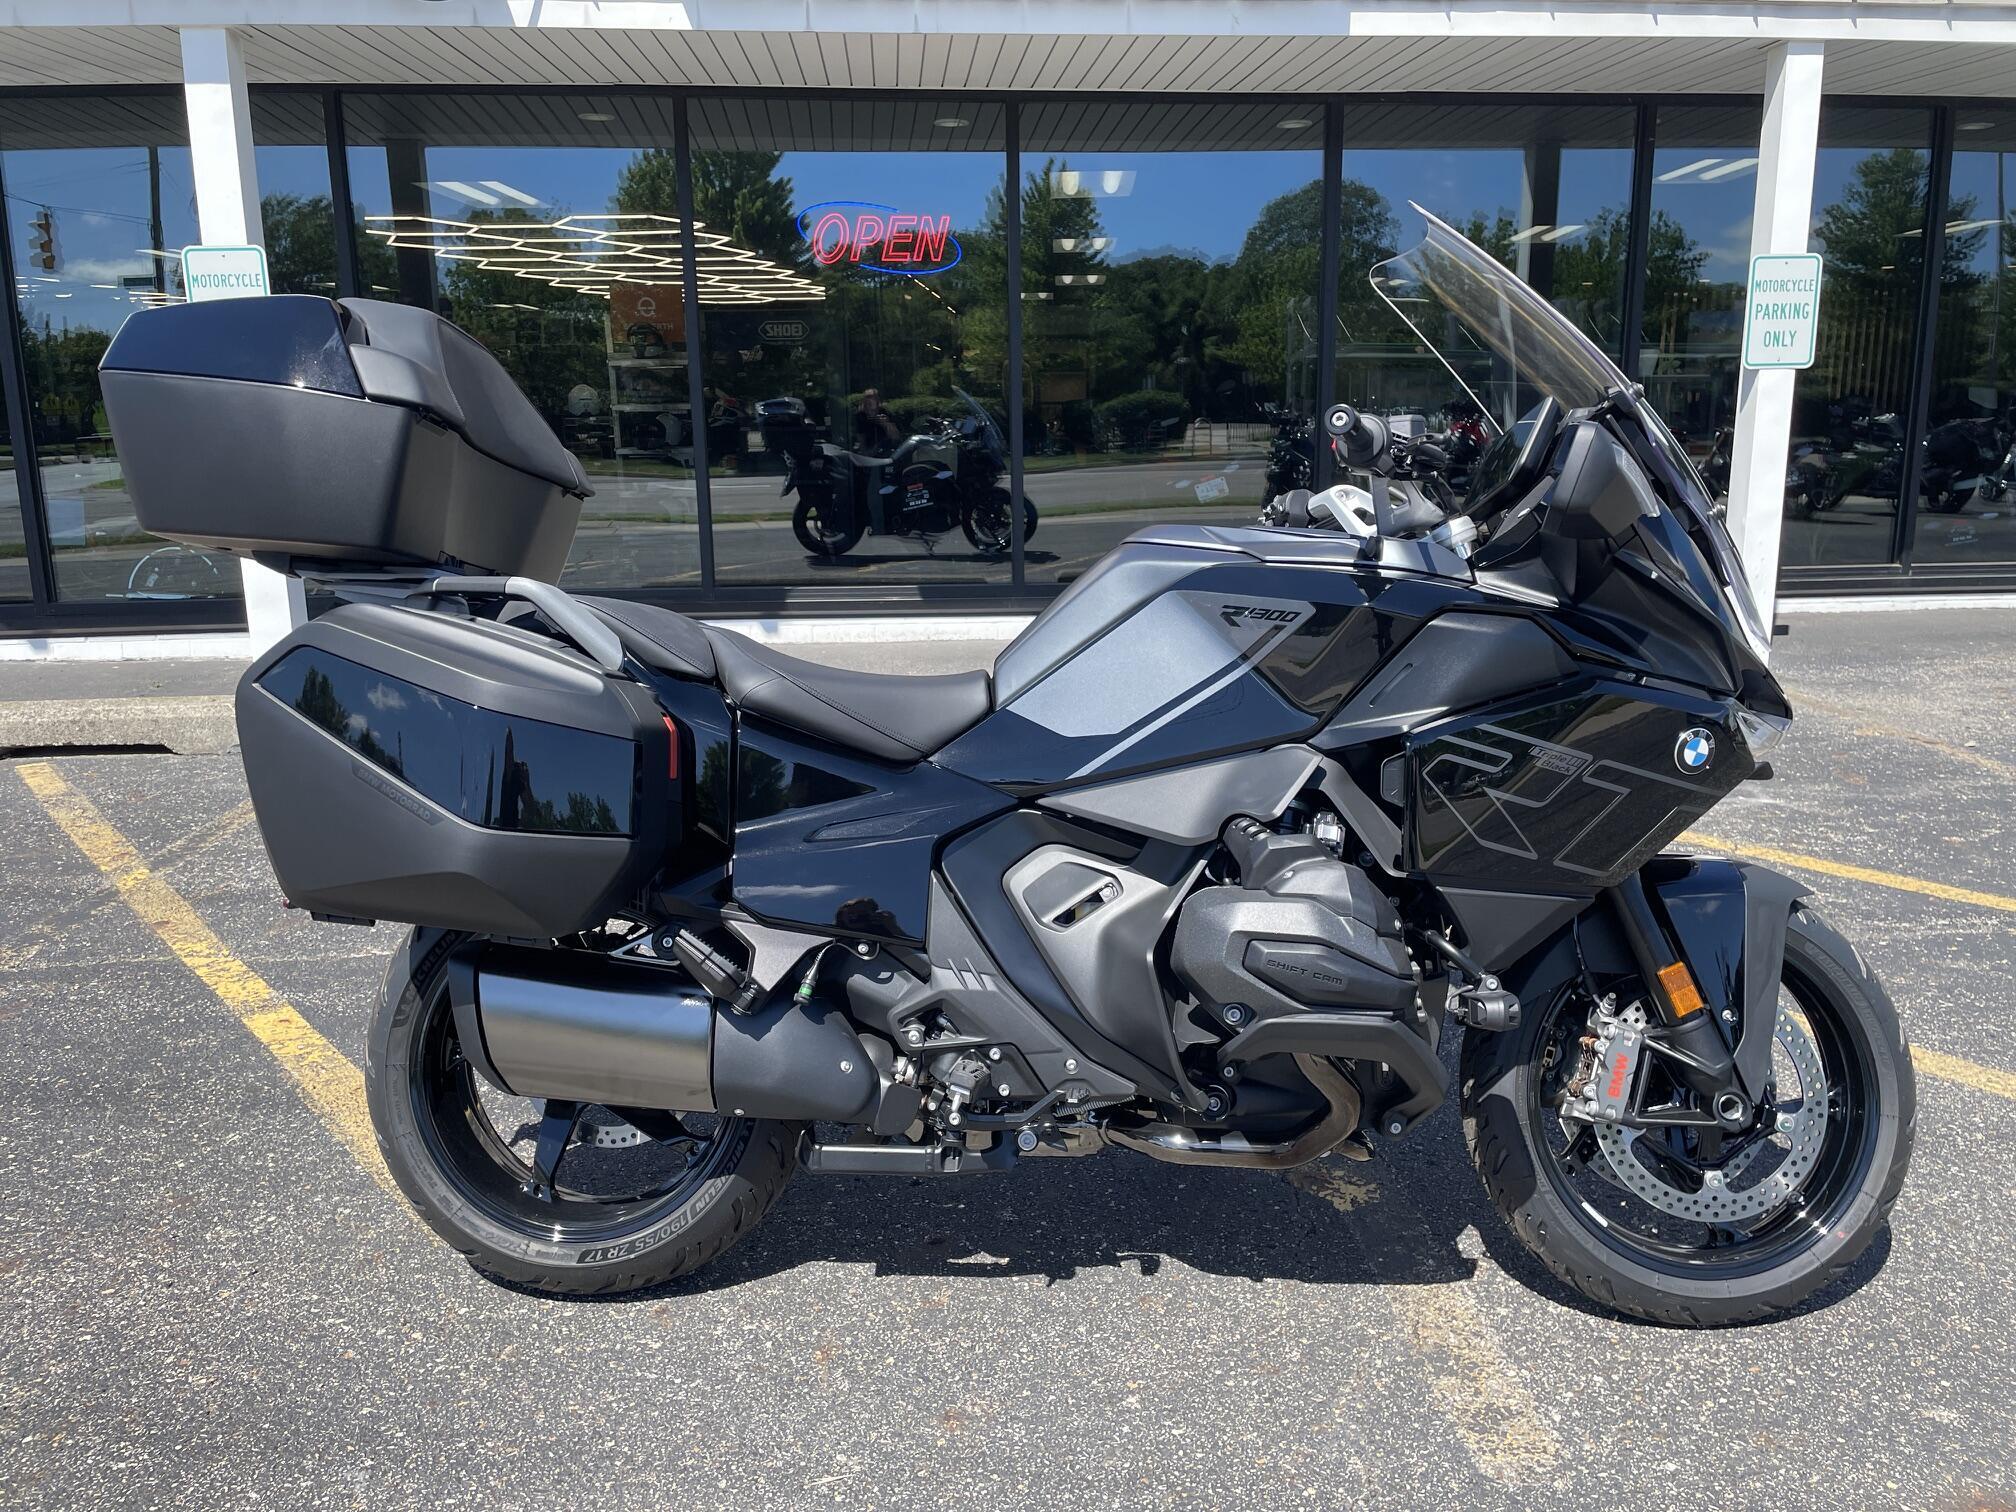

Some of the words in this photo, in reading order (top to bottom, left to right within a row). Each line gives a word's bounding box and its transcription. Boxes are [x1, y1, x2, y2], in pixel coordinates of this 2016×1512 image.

[813, 212, 950, 264] OPEN
[192, 273, 262, 288] MOTORCYCLE
[1754, 279, 1815, 293] MOTORCYCLE
[1755, 303, 1809, 320] PARKING
[1763, 330, 1797, 347] ONLY
[1537, 748, 1568, 764] Triple
[1540, 759, 1571, 774] Black
[1266, 959, 1308, 976] SHIFT
[1312, 972, 1343, 986] CAM
[1608, 1052, 1631, 1098] BMW
[635, 1216, 687, 1252] 190/55
